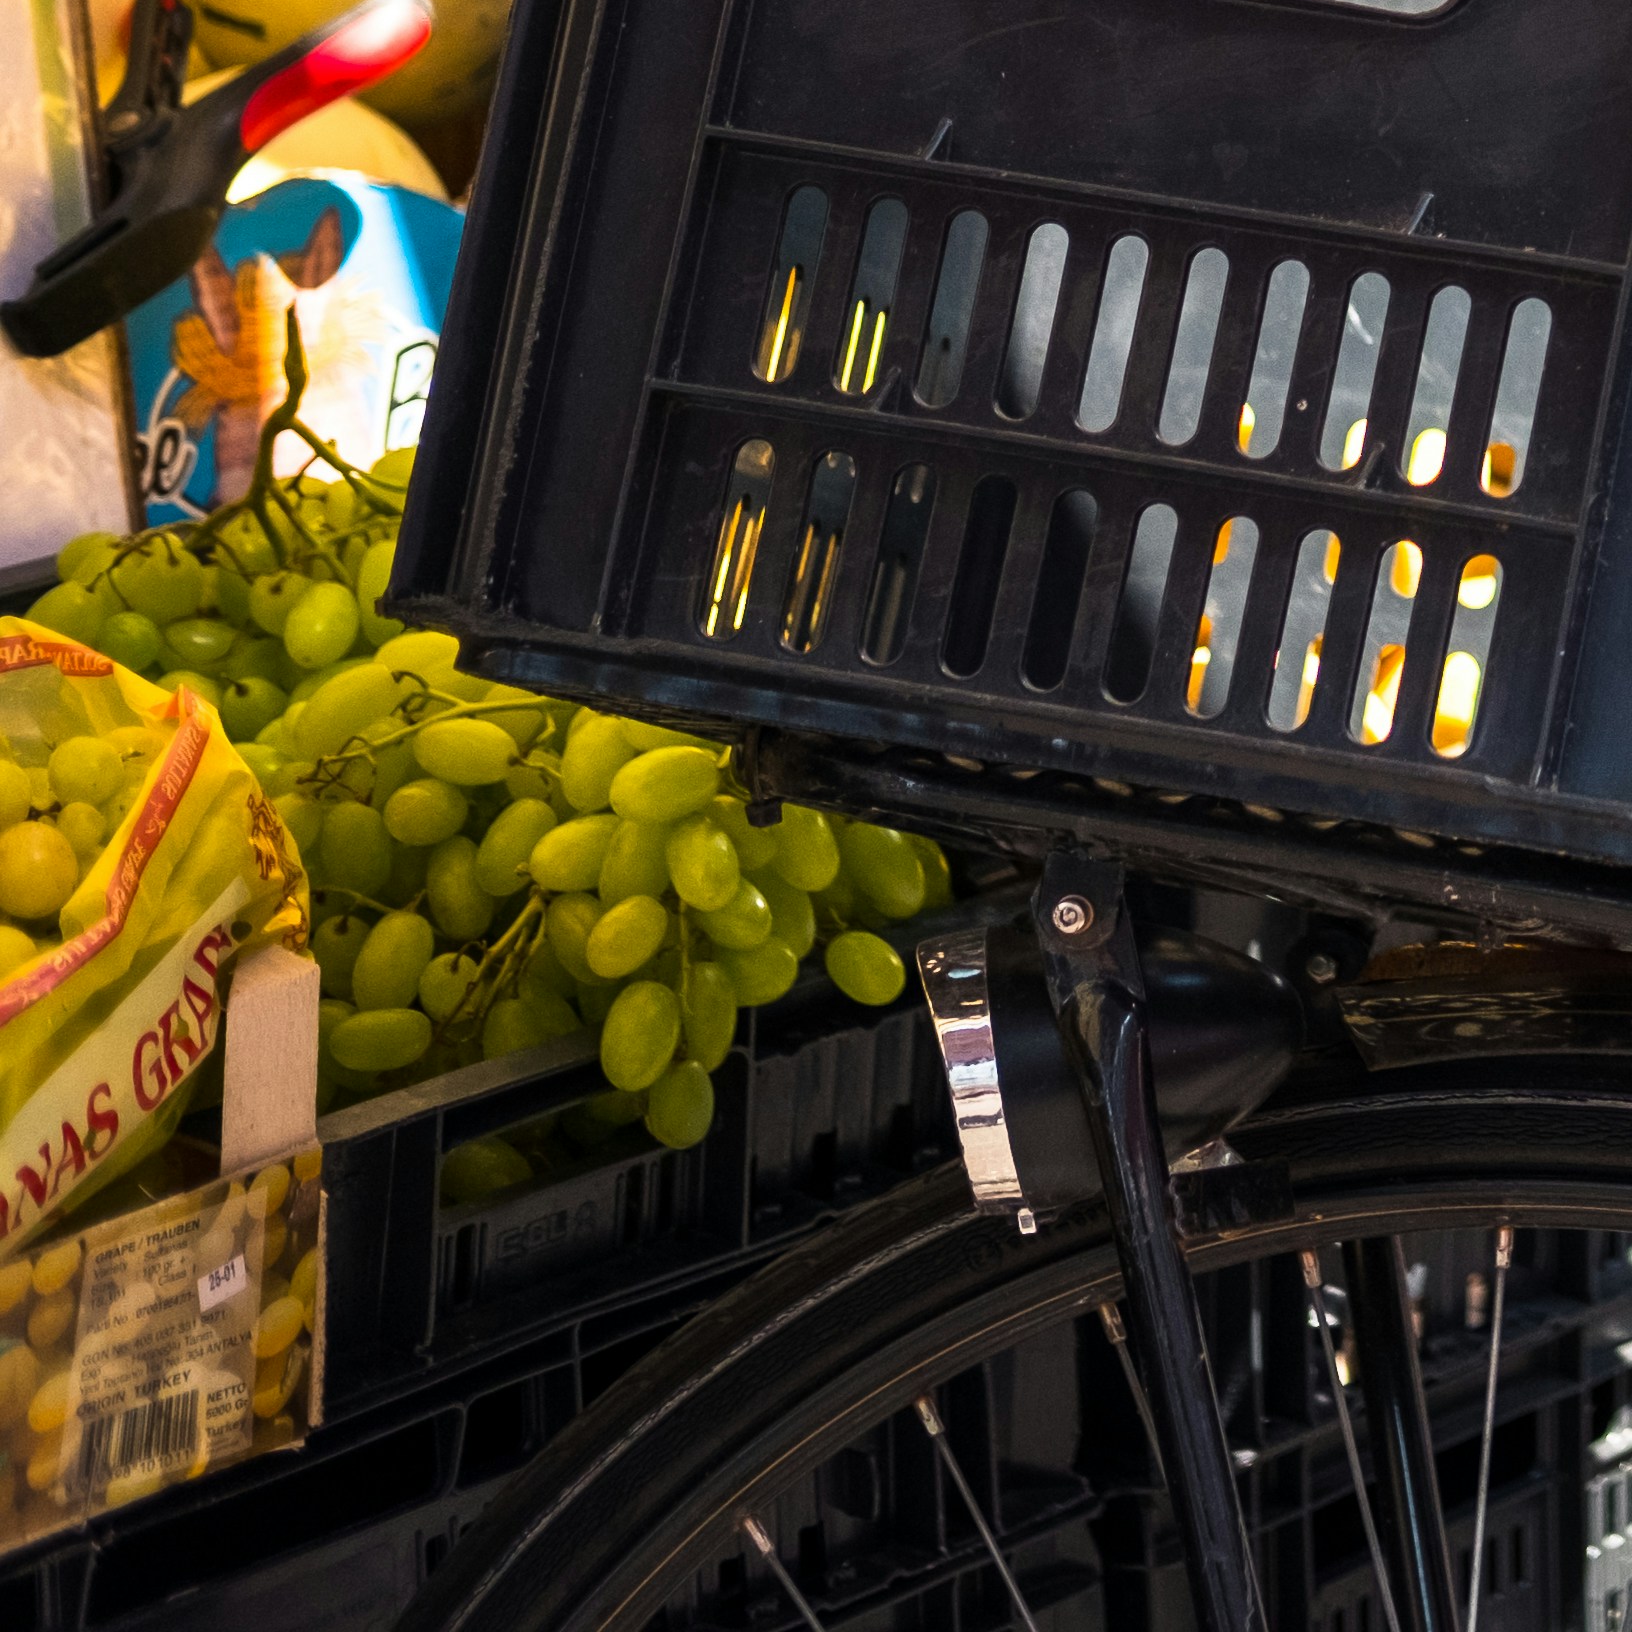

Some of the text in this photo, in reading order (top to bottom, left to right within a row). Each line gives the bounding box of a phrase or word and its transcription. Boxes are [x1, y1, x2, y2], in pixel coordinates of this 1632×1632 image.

[95, 1240, 136, 1265] GRAPE
[145, 1218, 201, 1247] TRAUBEN
[77, 1369, 193, 1418] ORIGIN TURKEY
[206, 1381, 248, 1404] NETTO
